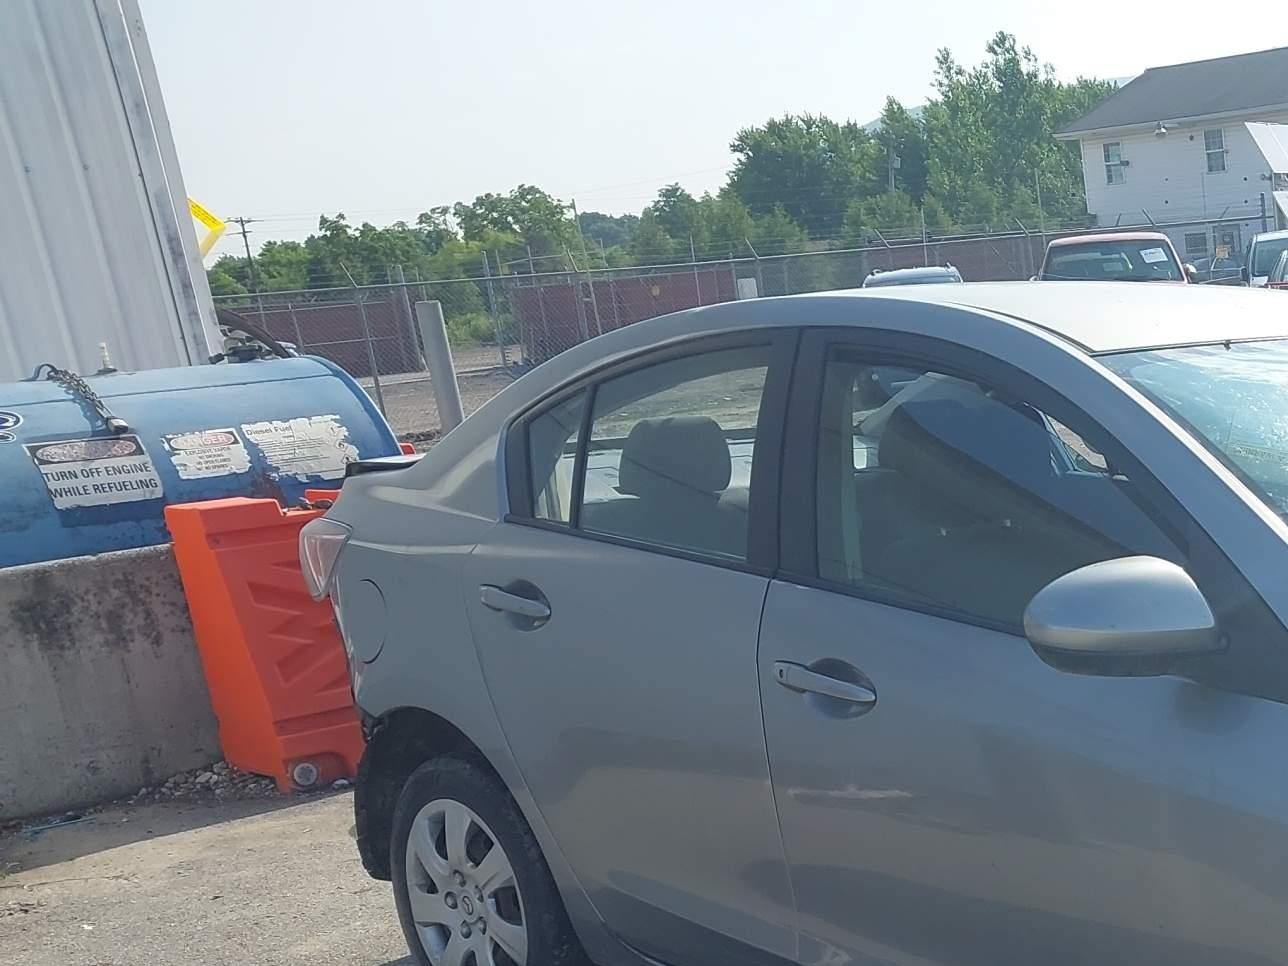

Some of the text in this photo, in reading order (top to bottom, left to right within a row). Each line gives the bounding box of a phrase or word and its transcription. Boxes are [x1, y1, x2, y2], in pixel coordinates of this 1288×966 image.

[245, 425, 292, 436] Diesel Fuel
[44, 462, 151, 482] TURN OFF ENGINE
[49, 478, 158, 499] WHILE REFUELING
